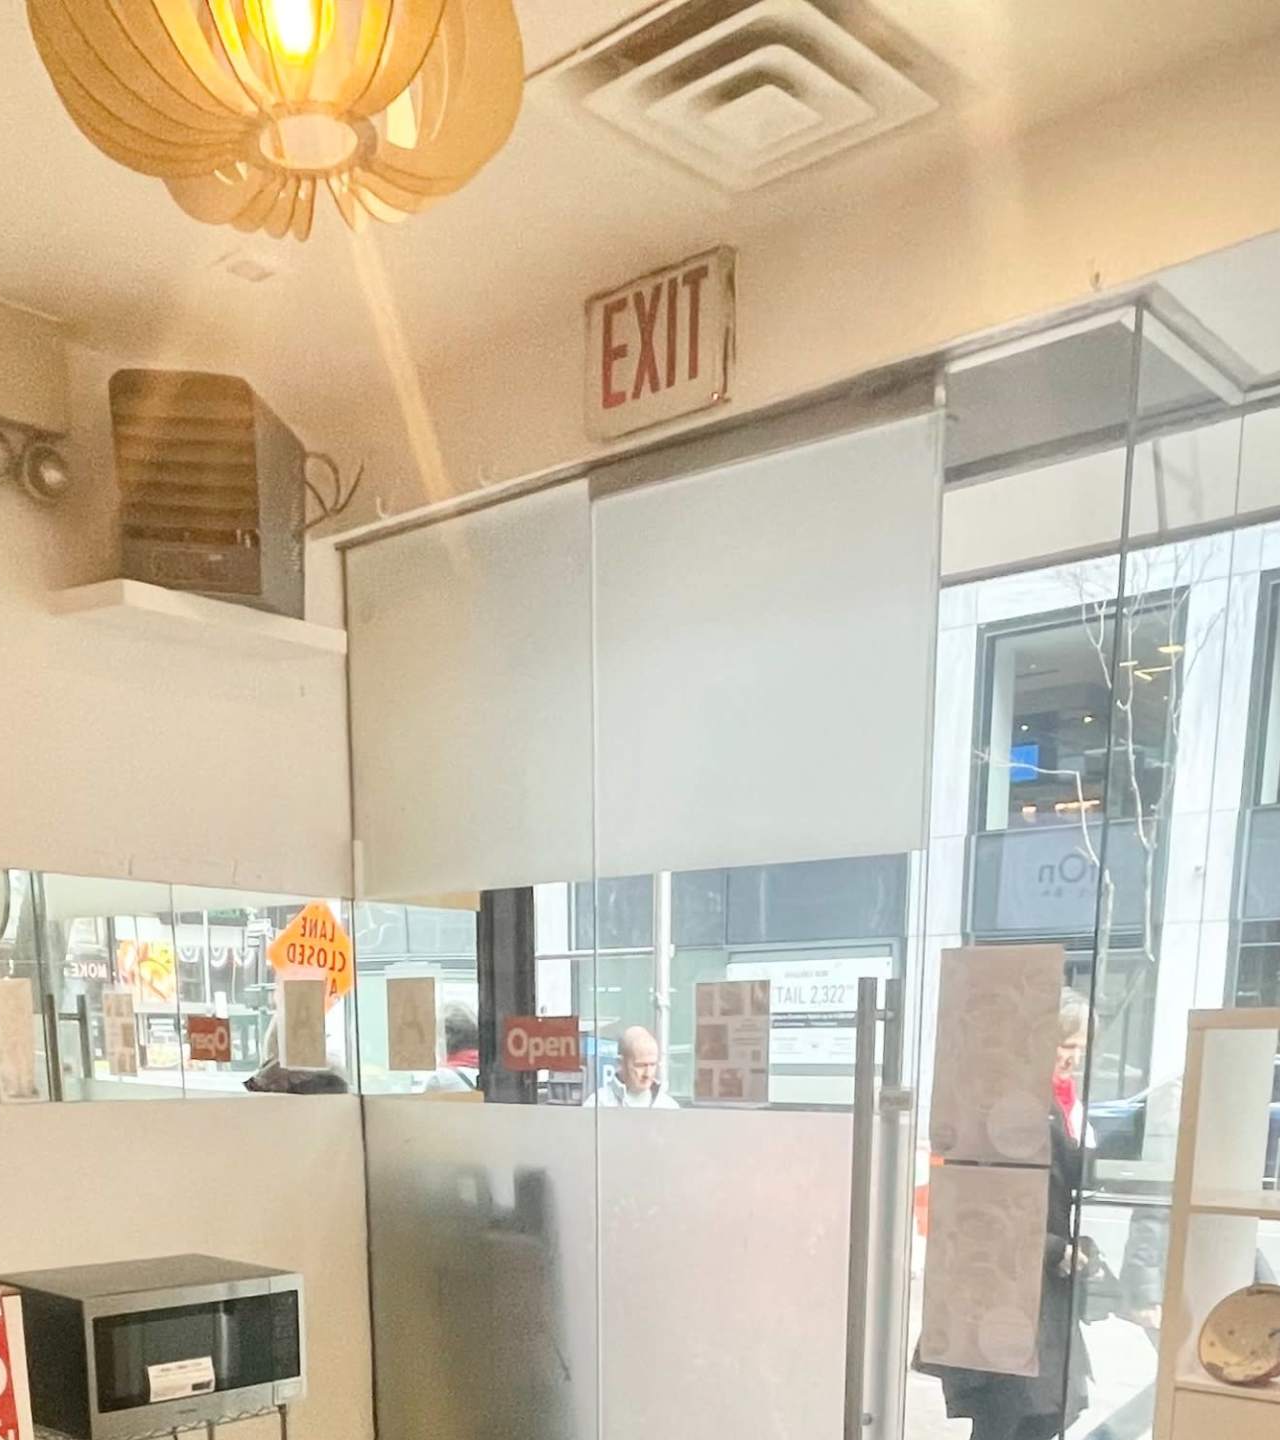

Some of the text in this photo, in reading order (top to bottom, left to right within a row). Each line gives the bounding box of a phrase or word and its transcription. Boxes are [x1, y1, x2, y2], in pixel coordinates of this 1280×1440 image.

[602, 265, 709, 410] EXIT
[775, 986, 807, 1004] TAIL
[507, 1027, 576, 1065] Open
